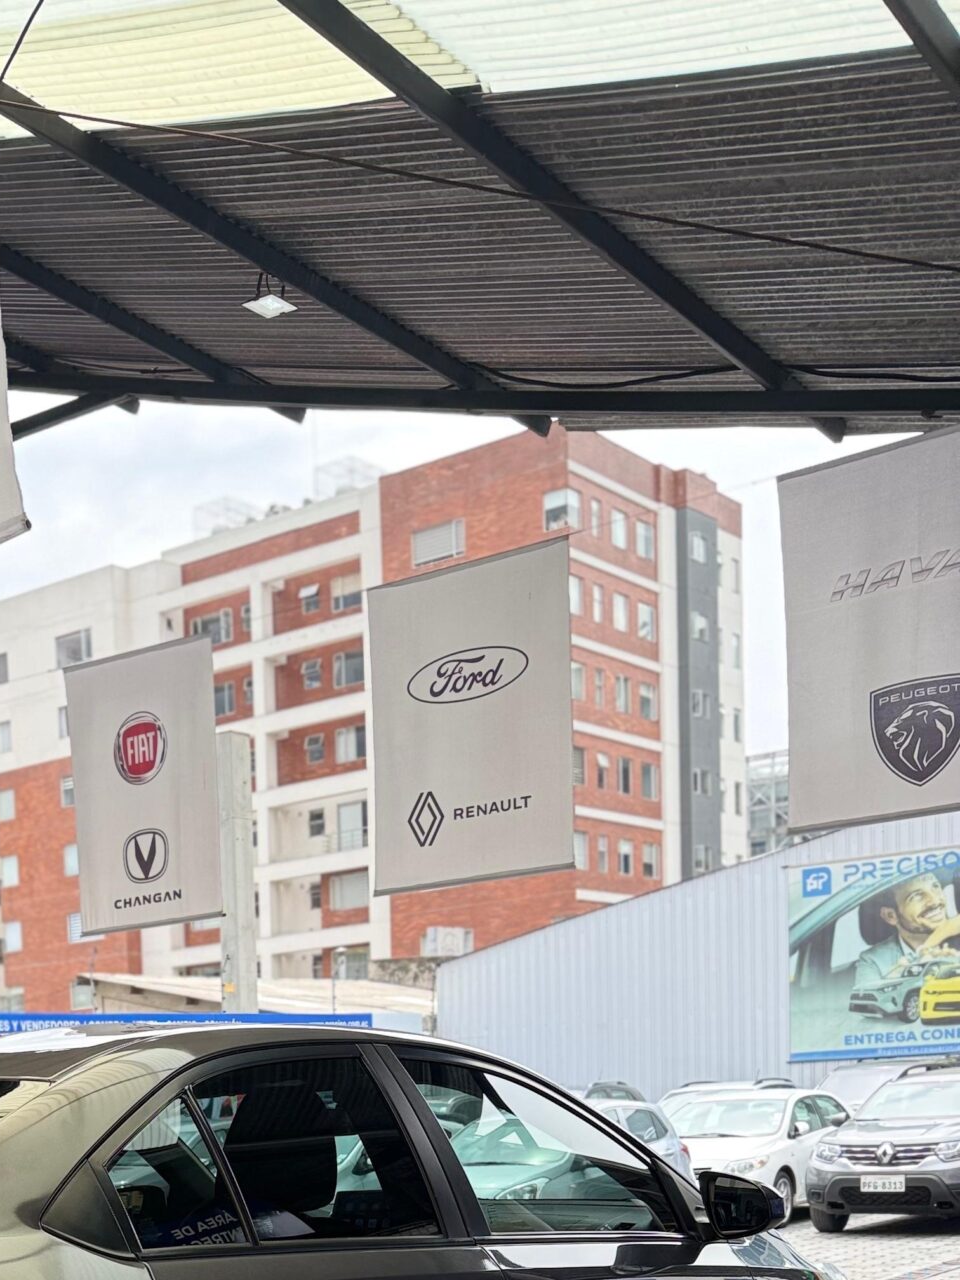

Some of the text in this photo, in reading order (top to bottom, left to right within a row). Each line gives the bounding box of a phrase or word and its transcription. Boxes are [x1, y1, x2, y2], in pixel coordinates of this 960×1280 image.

[430, 654, 505, 698] Ford
[879, 683, 960, 706] PEUGEOT
[126, 731, 157, 767] FIAT
[453, 795, 533, 821] RENAULT
[843, 851, 960, 882] PRECISO
[114, 889, 182, 910] CHANGAN
[11, 1020, 19, 1031] Y
[843, 1031, 917, 1046] ENTREGA
